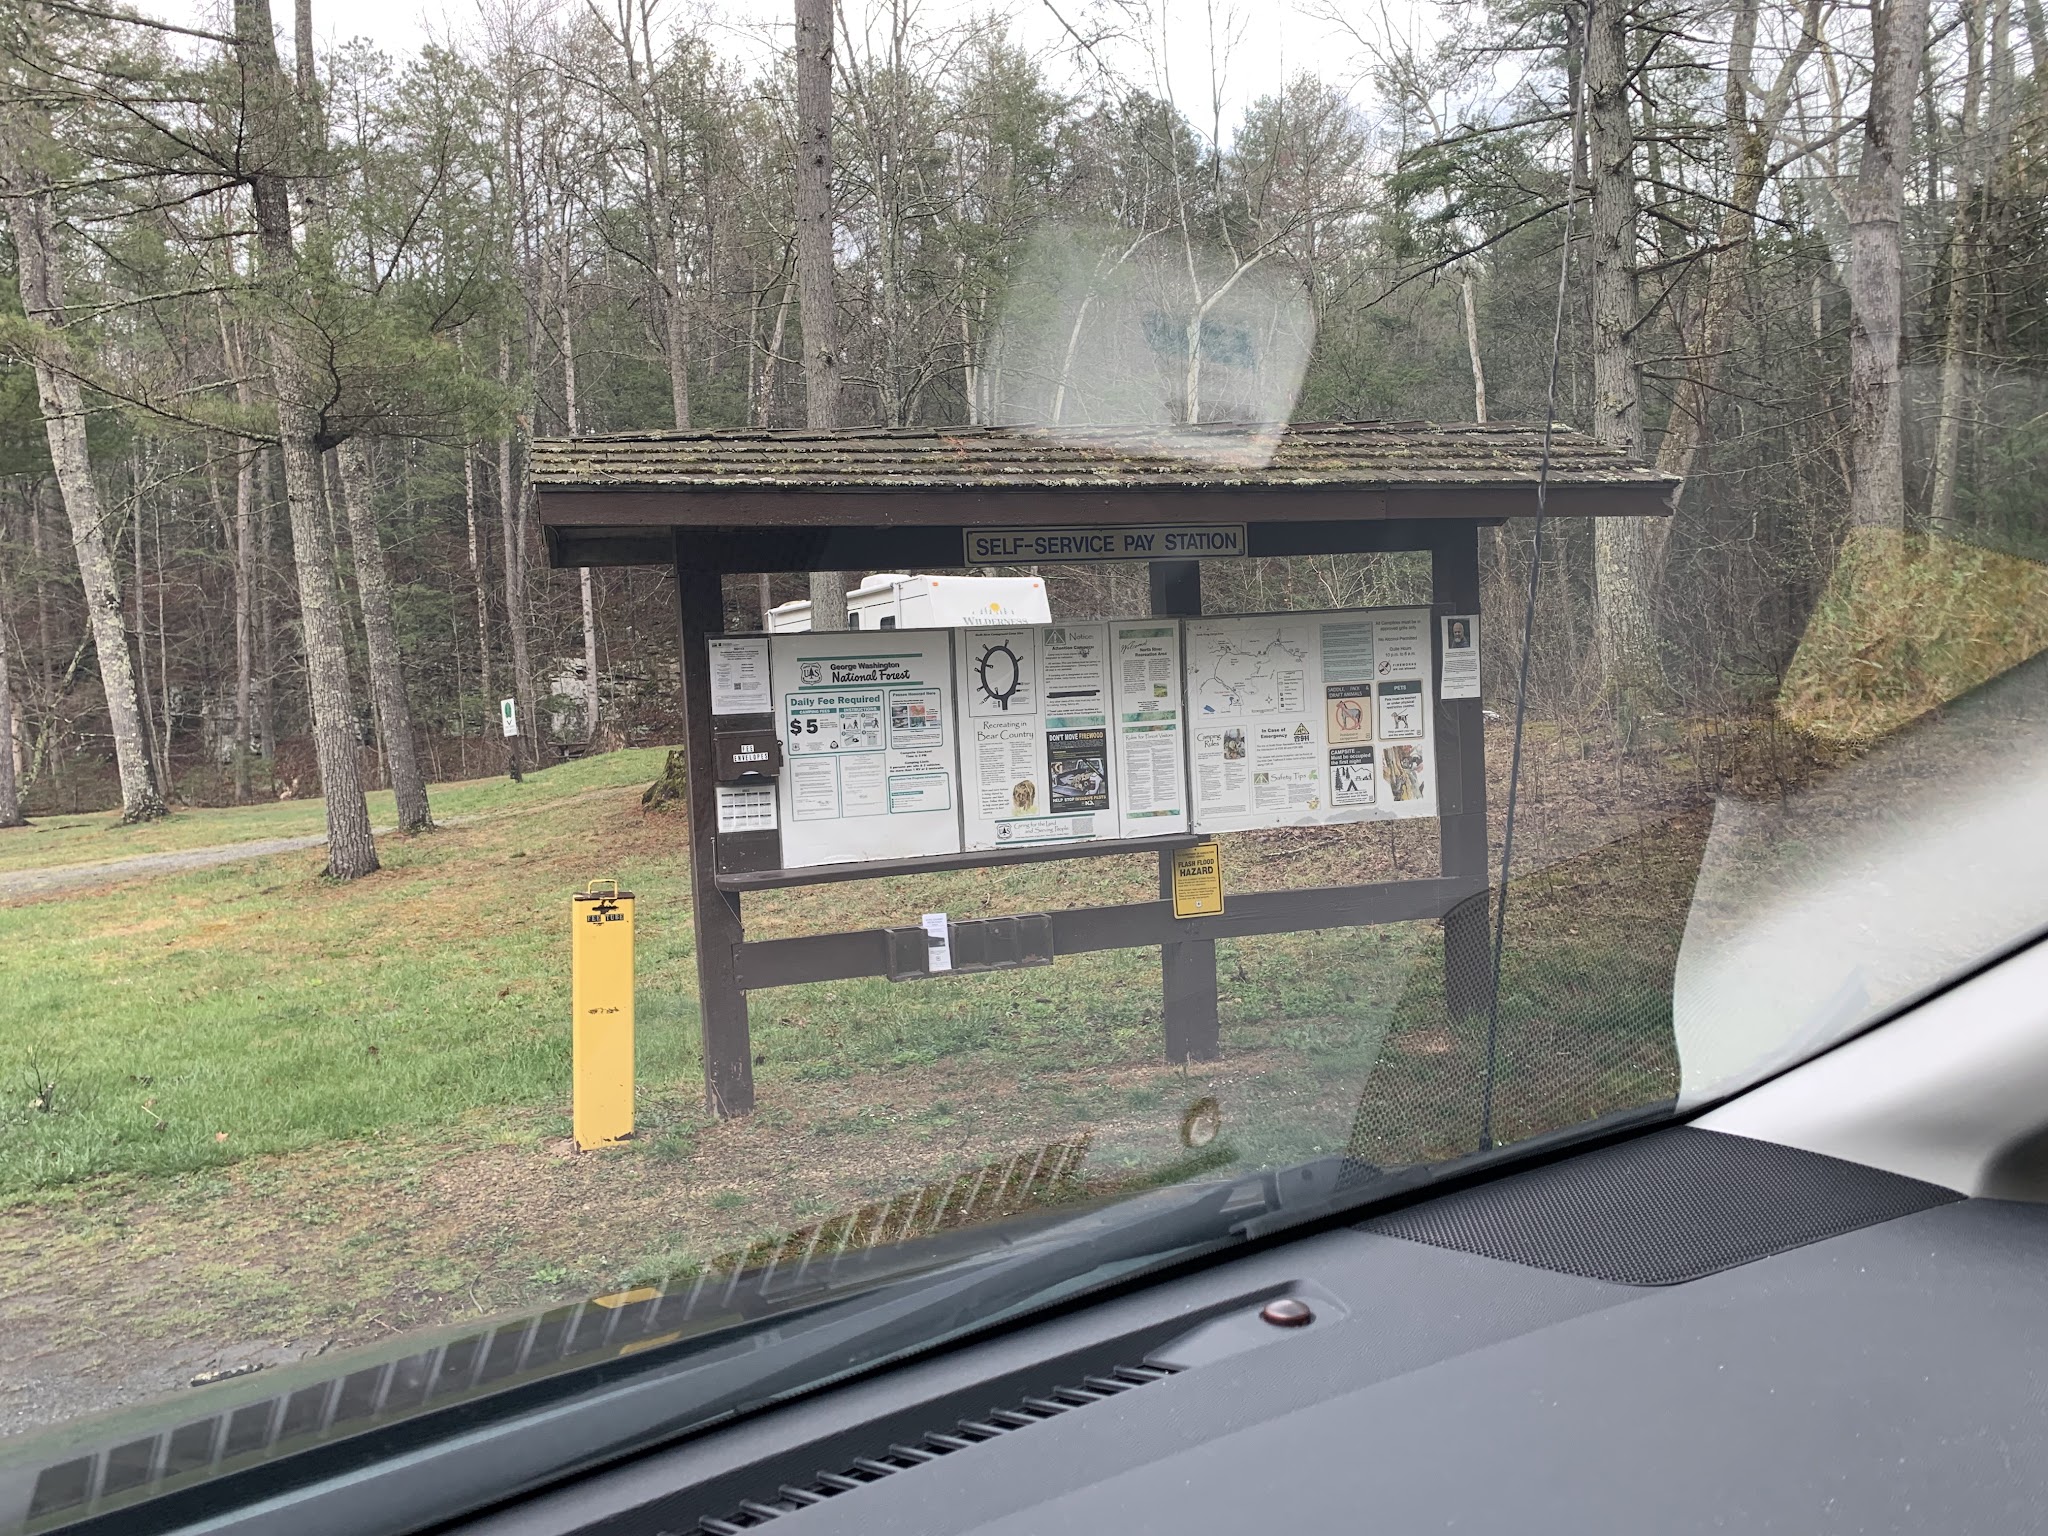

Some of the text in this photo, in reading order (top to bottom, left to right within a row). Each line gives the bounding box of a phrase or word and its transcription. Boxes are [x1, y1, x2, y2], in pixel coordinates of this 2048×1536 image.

[976, 532, 1237, 556] SELF-SERVICE PAY STATION
[830, 662, 900, 671] George Washington
[832, 669, 911, 683] National Forest
[791, 695, 880, 707] Daily Fee Required
[983, 721, 1021, 730] Recreating
[977, 730, 1034, 742] Bear Country
[1079, 732, 1104, 740] FIREWOOD
[1196, 732, 1222, 742] Camping
[1204, 739, 1220, 748] Rules
[742, 745, 754, 753] FEE
[734, 752, 768, 762] ENVELOPES
[1270, 772, 1306, 782] Safety Tips
[1180, 866, 1214, 877] HAZARD
